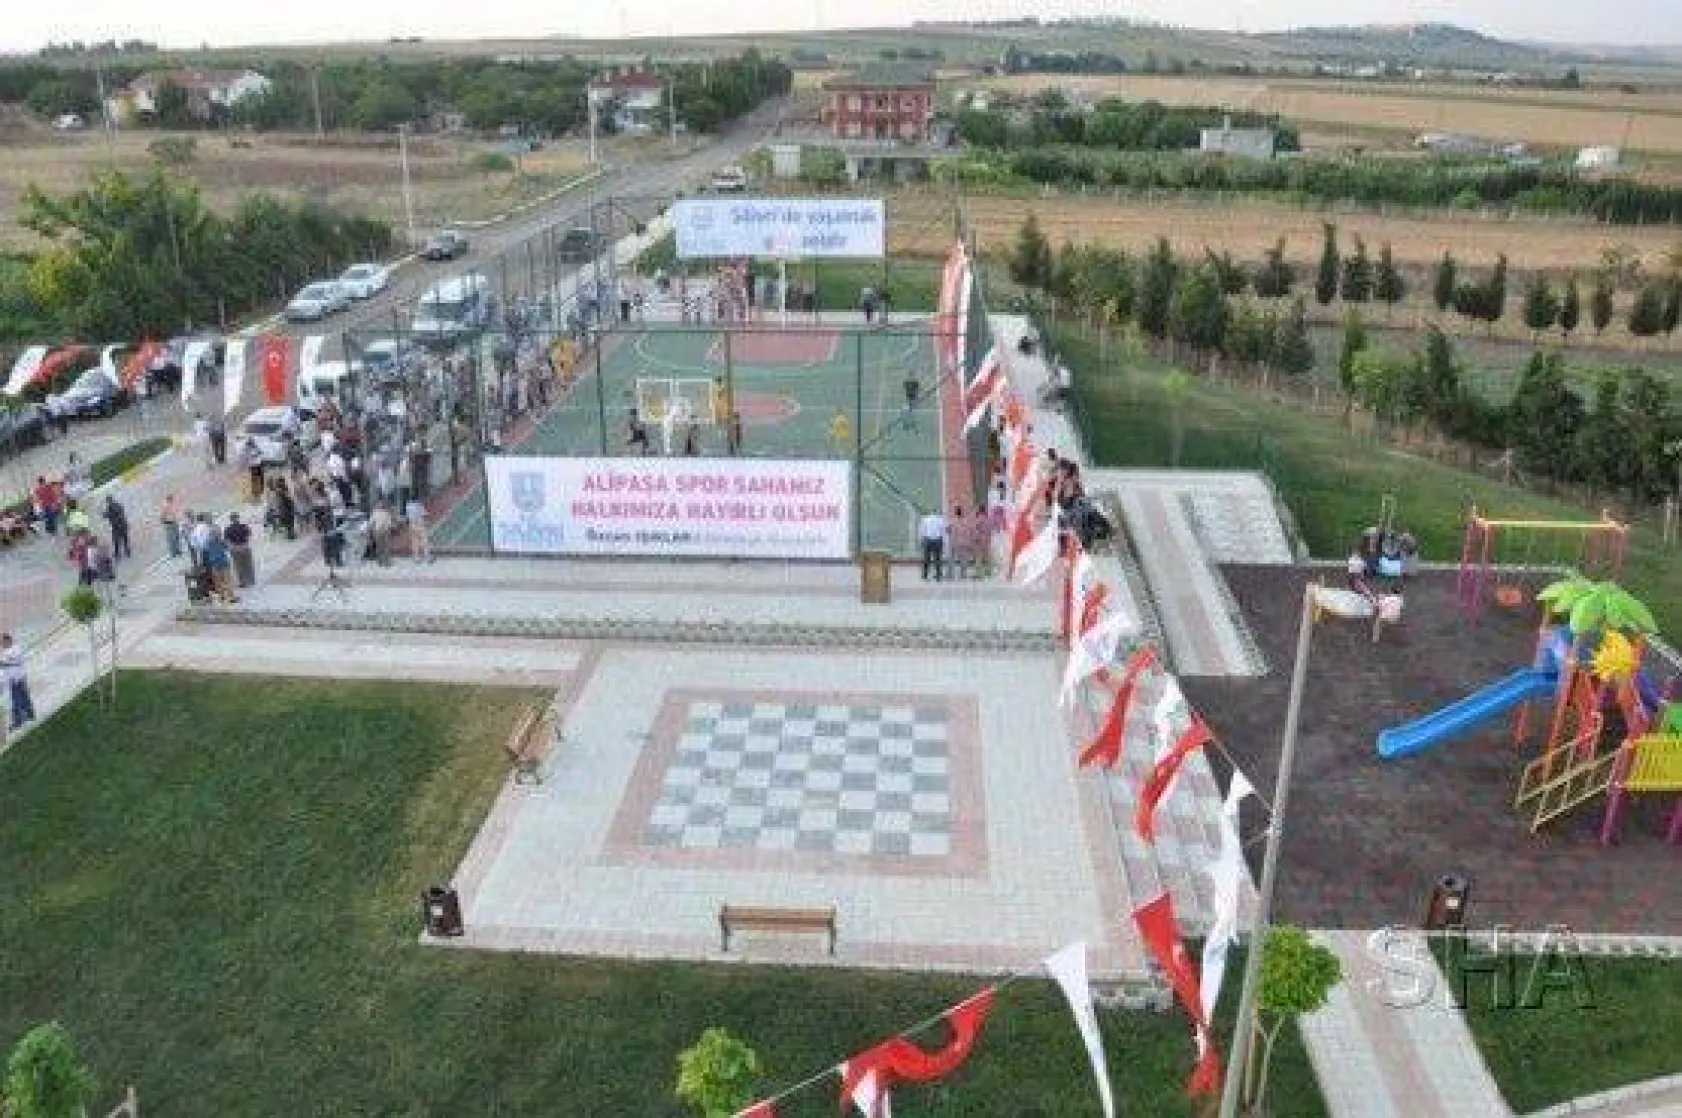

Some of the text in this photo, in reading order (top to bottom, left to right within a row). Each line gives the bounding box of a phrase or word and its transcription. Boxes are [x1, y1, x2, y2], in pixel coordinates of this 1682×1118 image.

[675, 474, 729, 494] SPOR
[733, 476, 825, 495] SAHAMIZ
[572, 501, 840, 522] HALKIMIZA HAYIRLI OLSUN
